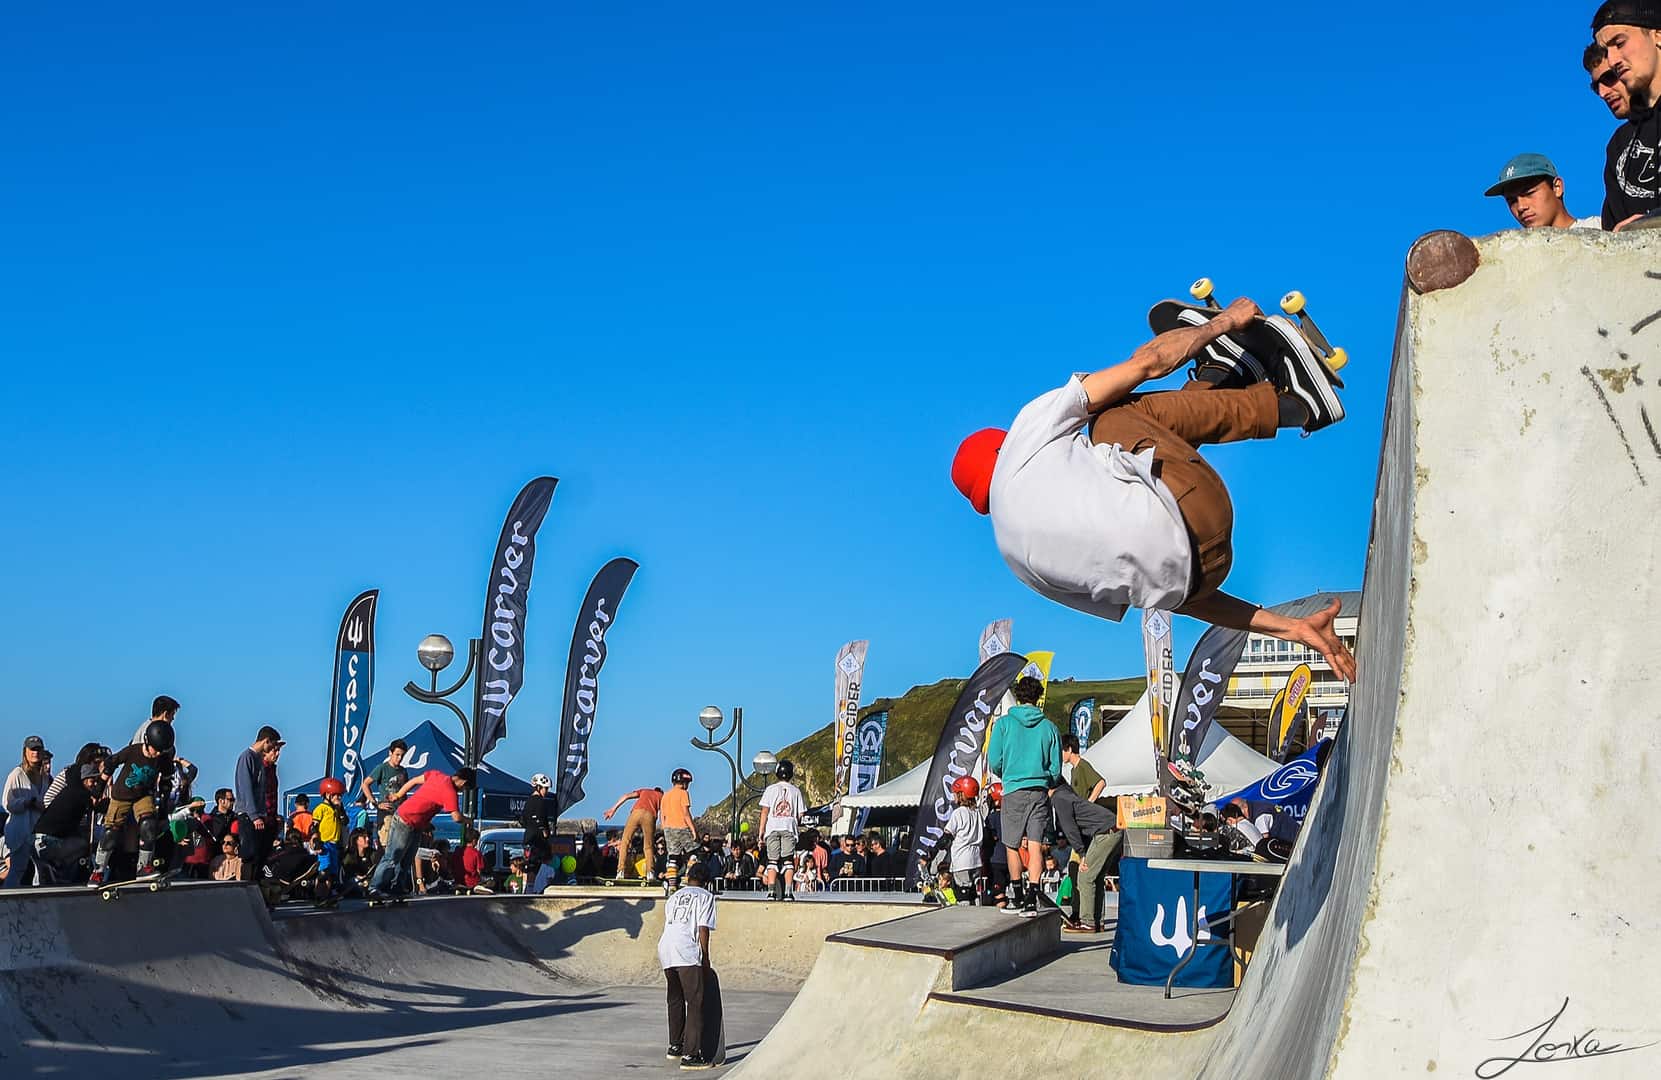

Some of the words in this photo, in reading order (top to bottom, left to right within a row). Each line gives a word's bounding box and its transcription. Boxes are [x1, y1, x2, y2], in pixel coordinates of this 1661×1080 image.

[488, 520, 529, 671] carver
[342, 654, 359, 792] carver
[573, 597, 610, 736] carver
[845, 682, 861, 728] CIDER
